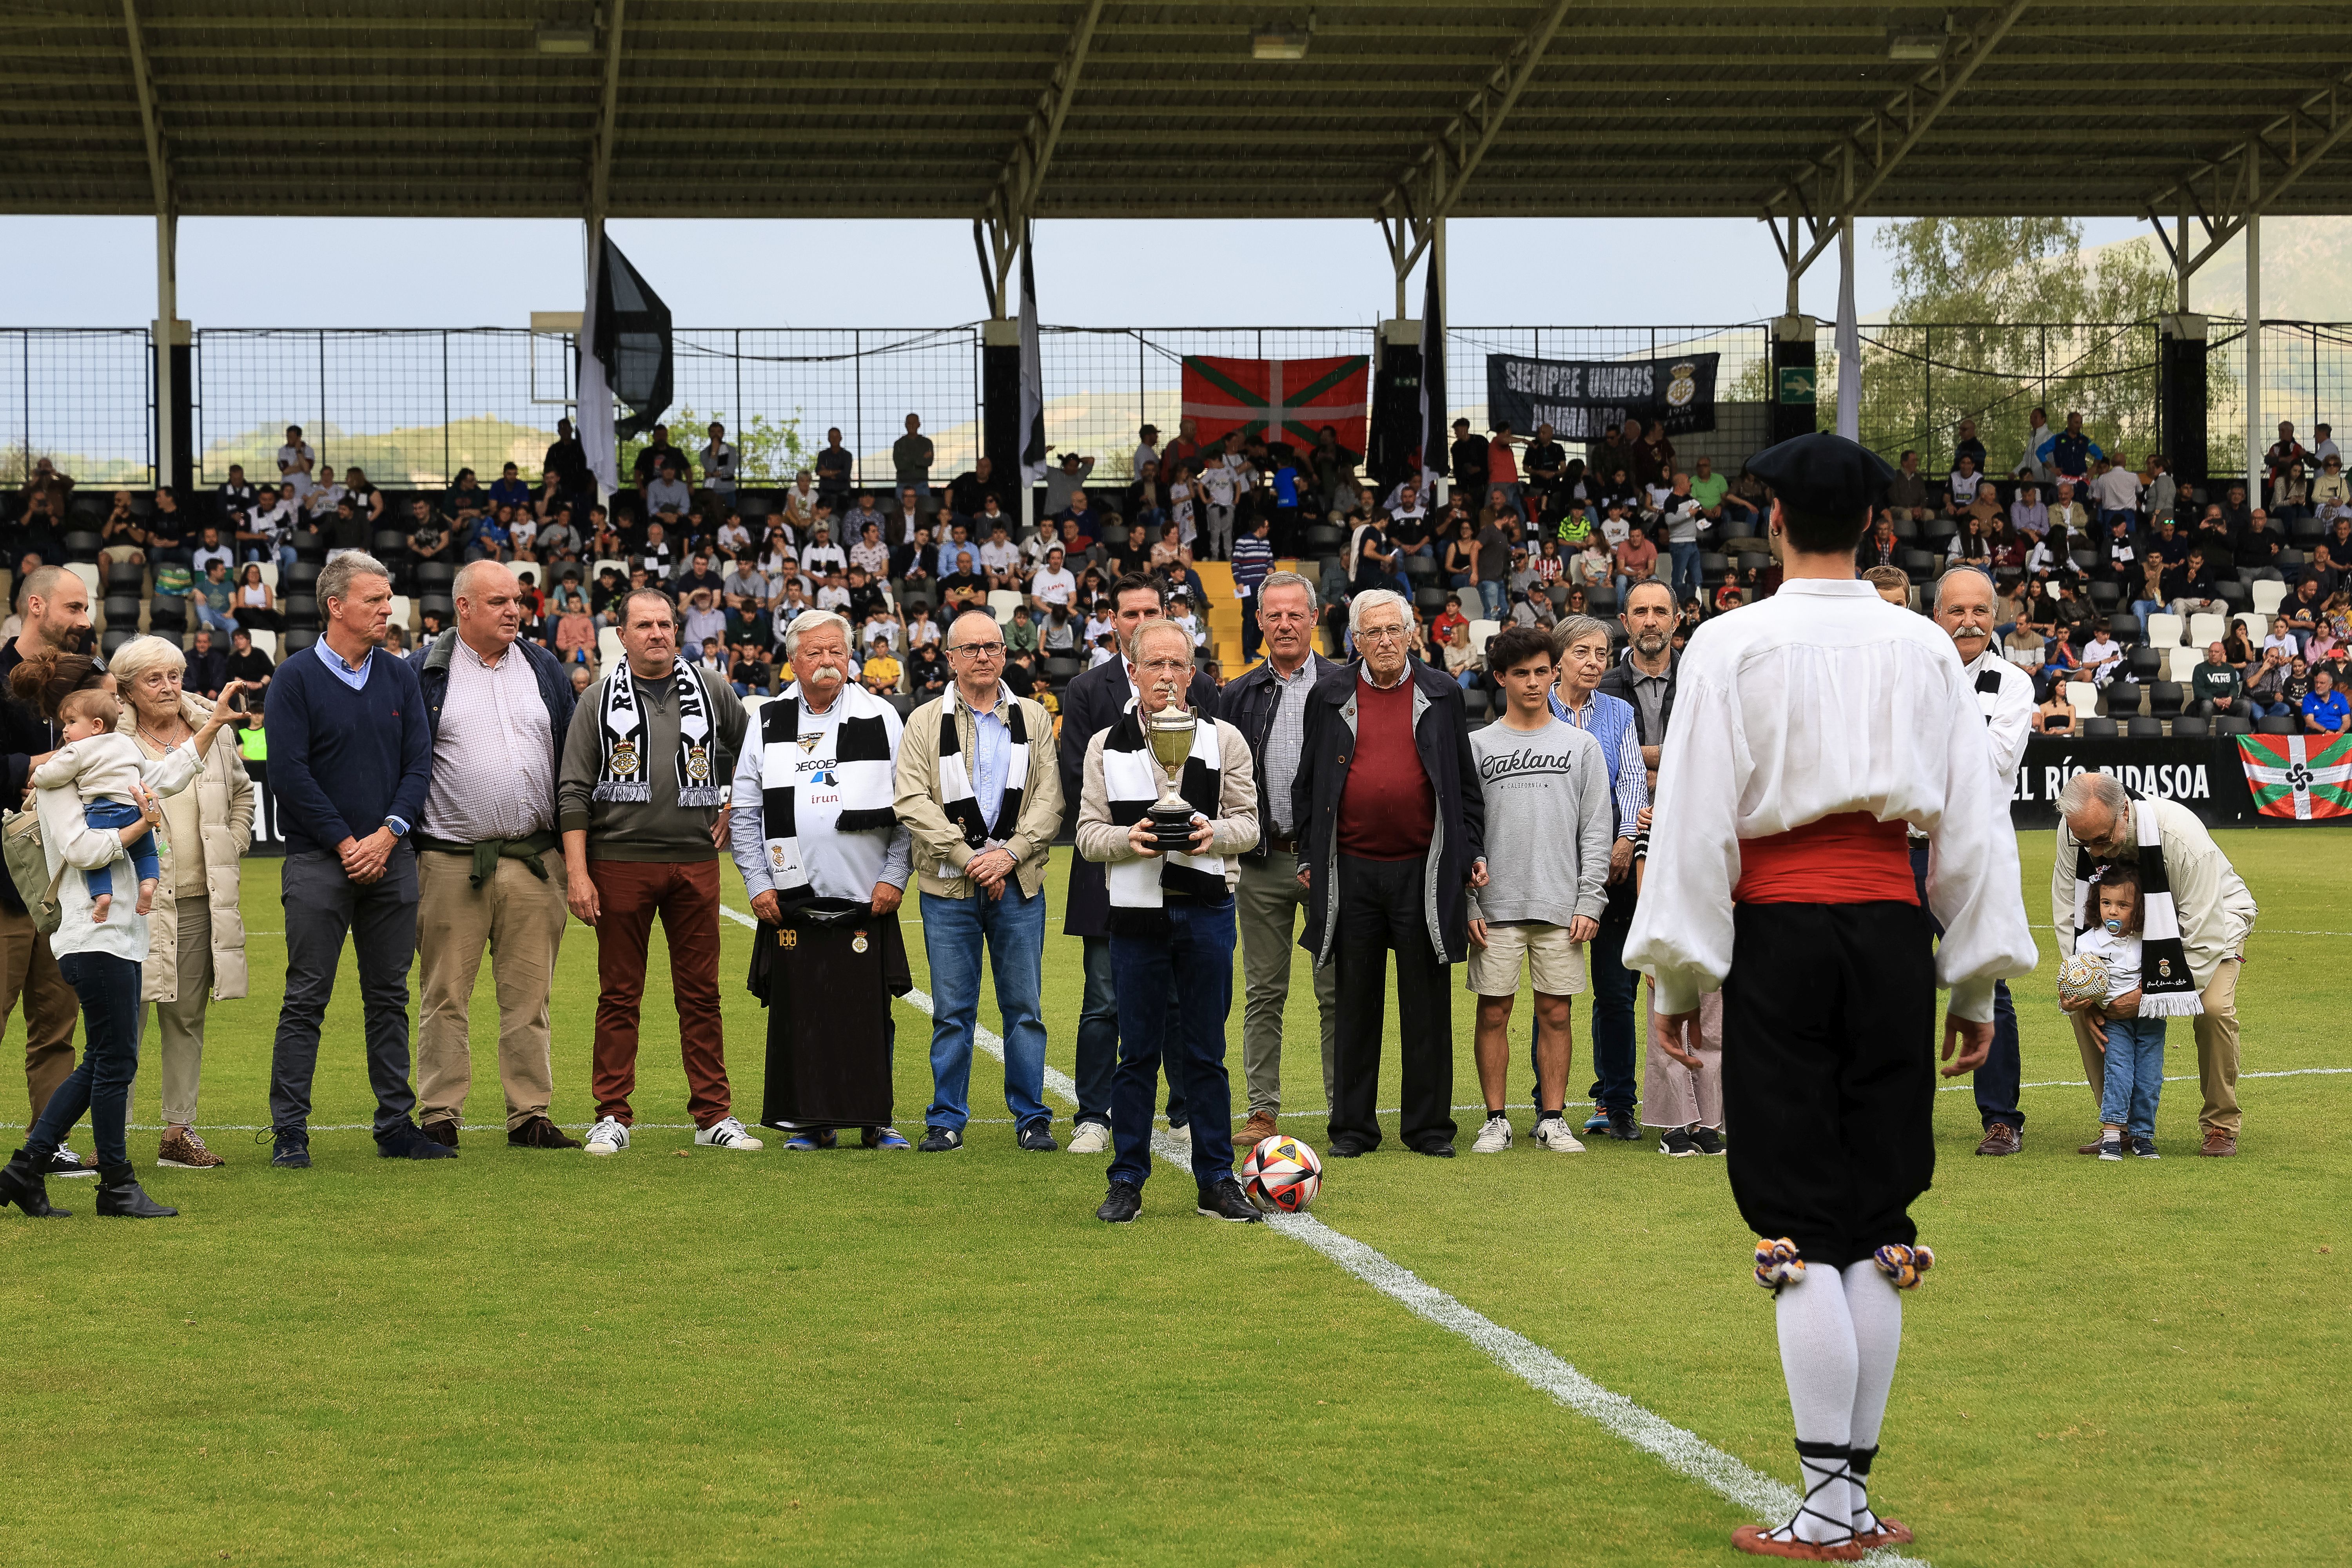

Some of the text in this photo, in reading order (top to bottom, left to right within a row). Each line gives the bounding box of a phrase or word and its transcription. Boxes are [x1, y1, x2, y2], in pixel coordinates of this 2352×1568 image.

[1505, 361, 1654, 398] SIEMPRE UNIDOS
[2207, 673, 2231, 683] VANS
[1481, 748, 1572, 781] Oakland
[2045, 756, 2086, 800] RÍ
